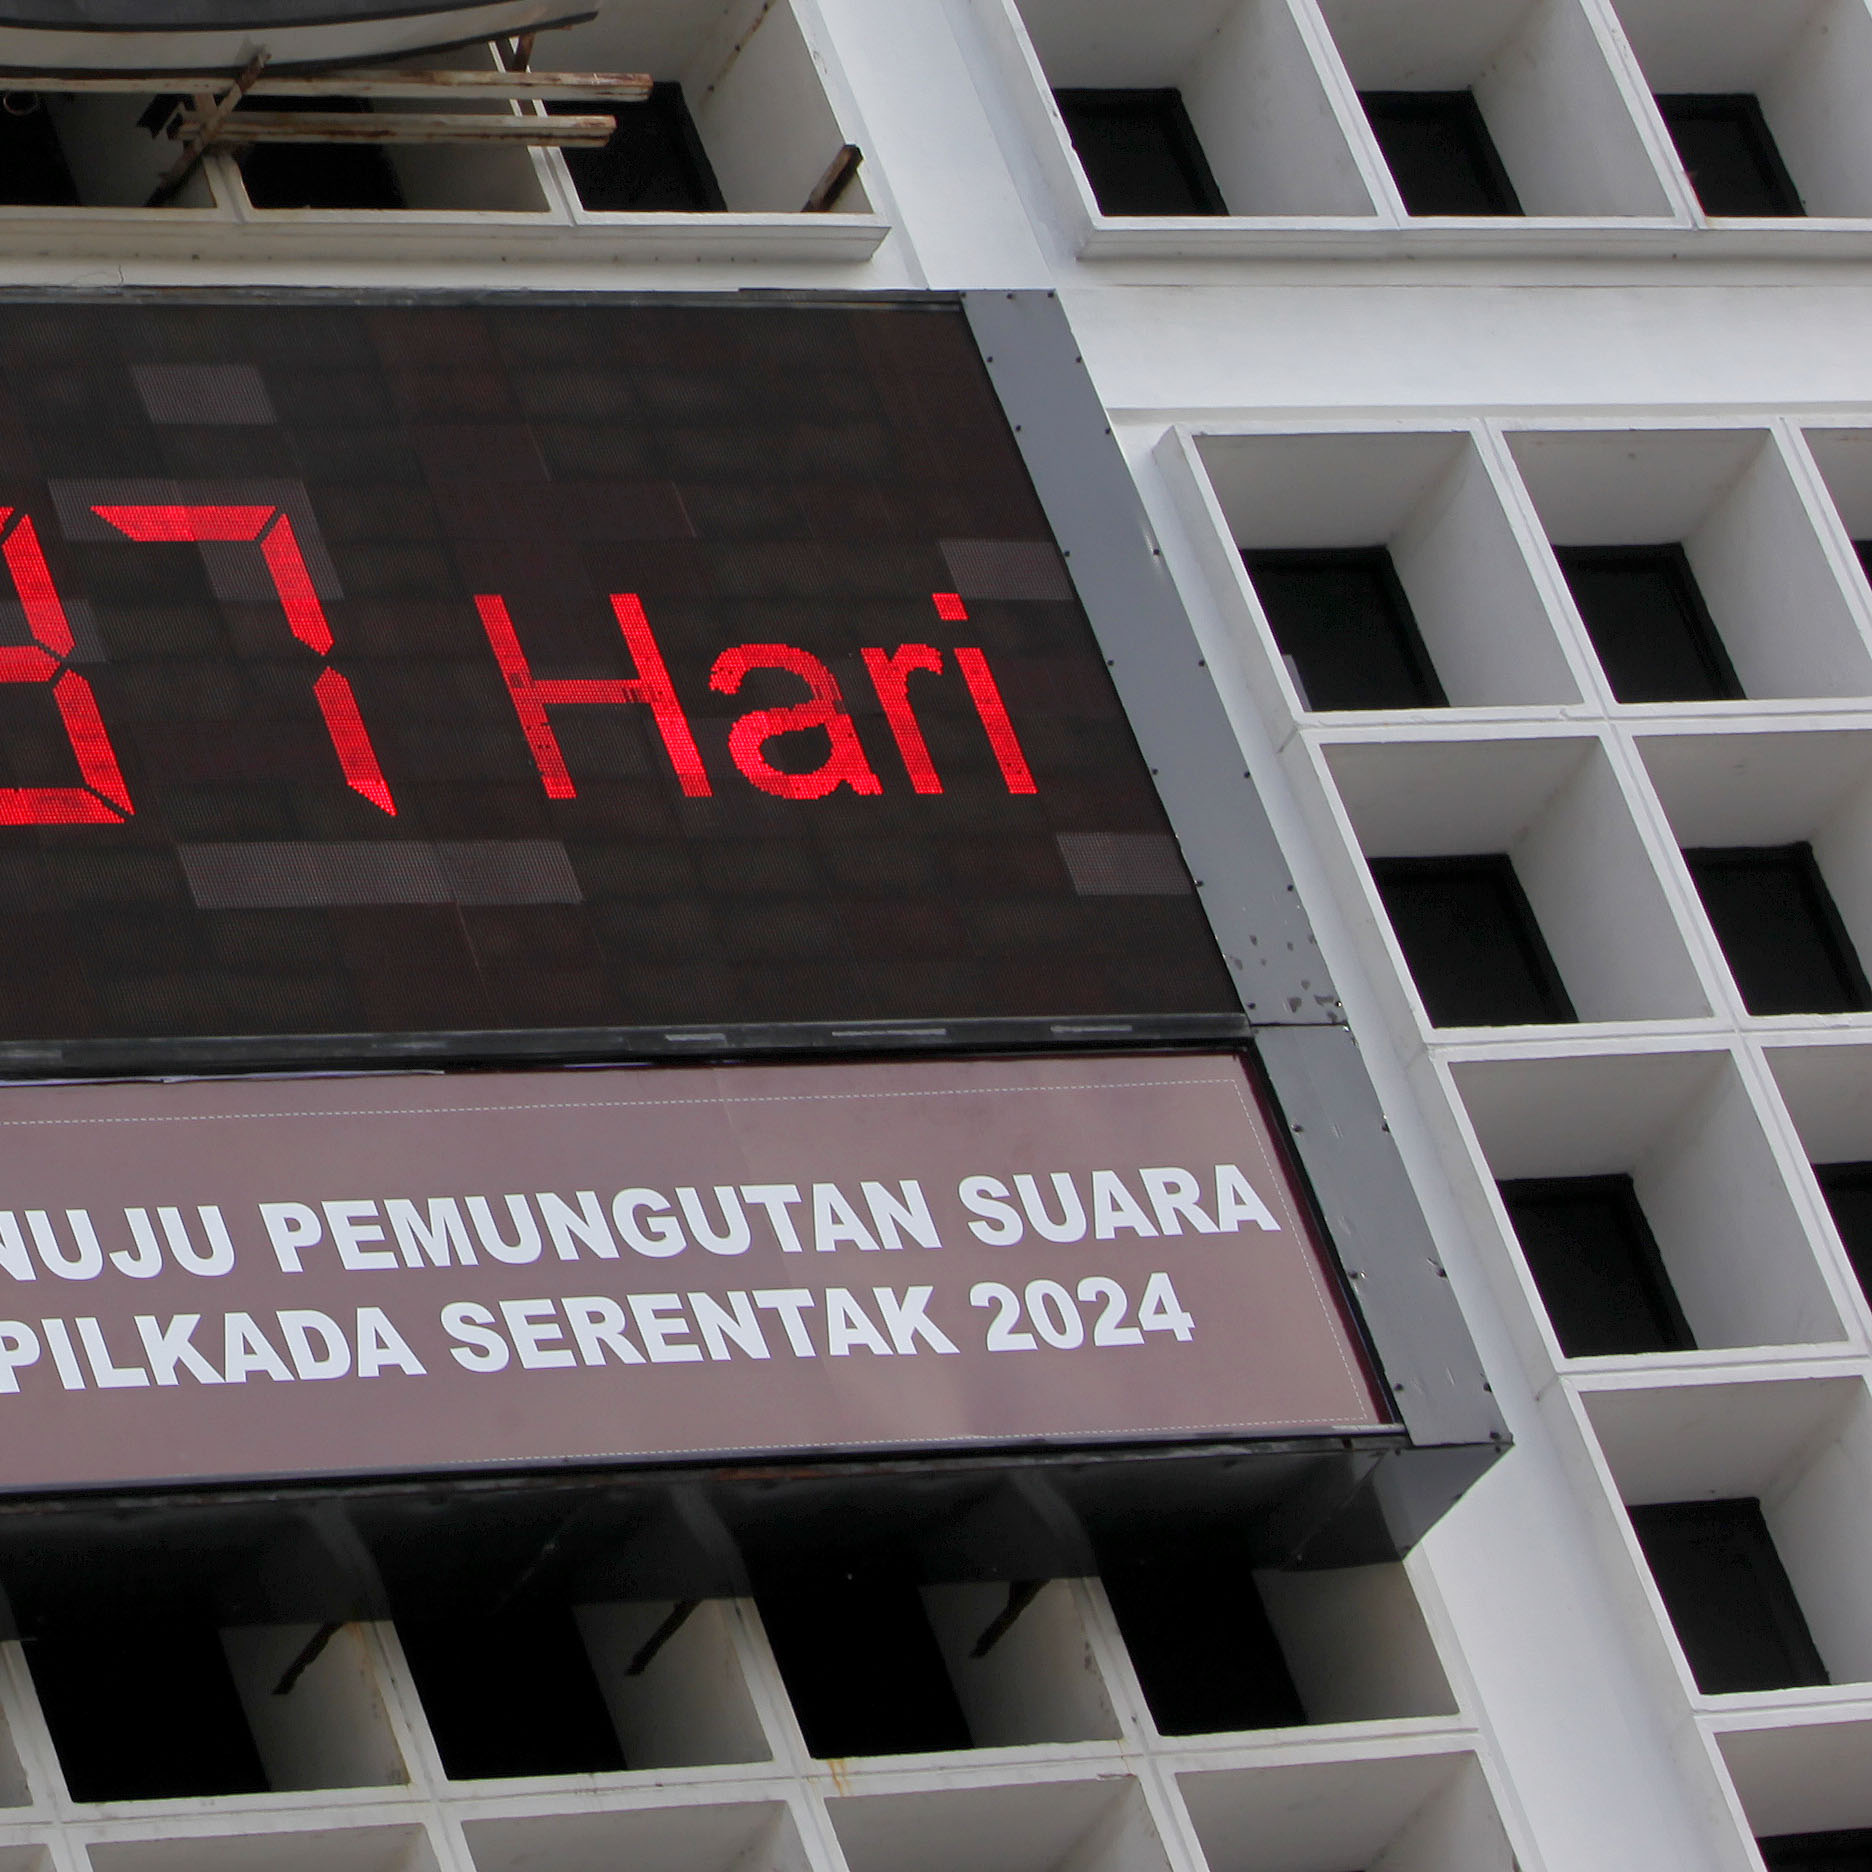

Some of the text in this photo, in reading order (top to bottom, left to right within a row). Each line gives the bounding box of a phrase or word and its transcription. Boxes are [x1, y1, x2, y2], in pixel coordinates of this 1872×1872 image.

[475, 592, 1038, 799] Hari
[258, 1177, 941, 1274] PEMUNGUTAN
[959, 1162, 1281, 1247] SUARA
[443, 1282, 959, 1374] SERENTAK
[972, 1269, 1196, 1355] 2024
